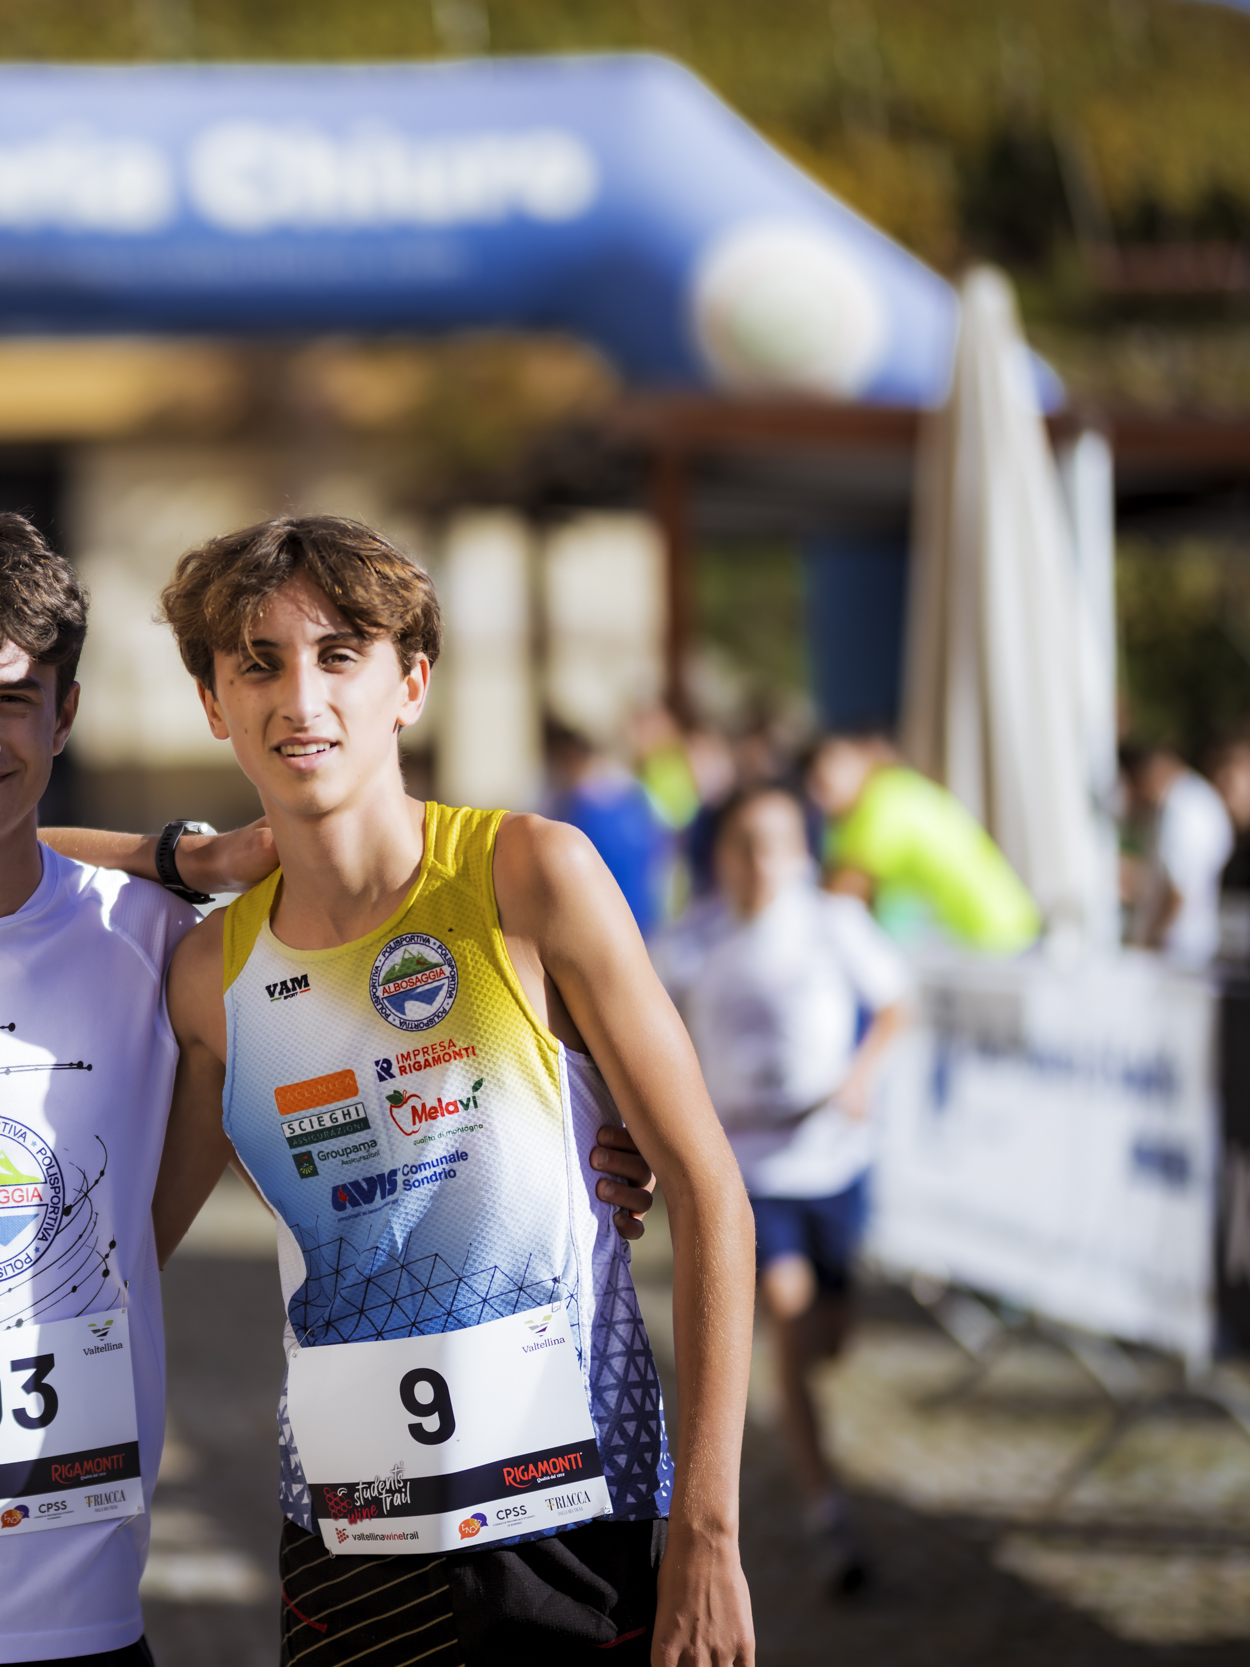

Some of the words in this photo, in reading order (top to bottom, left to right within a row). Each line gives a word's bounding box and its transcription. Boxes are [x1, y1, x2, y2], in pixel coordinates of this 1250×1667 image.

[265, 973, 310, 998] VAM
[382, 967, 446, 997] ALBOSAGGIA
[395, 1038, 457, 1065] IMPRESA
[398, 1045, 476, 1076] RIGAMONTI
[287, 1106, 360, 1135] SCIEGHI
[411, 1090, 481, 1126] Melavi
[292, 1121, 364, 1146] ASSICURAZIONI
[446, 1124, 484, 1135] montagna
[317, 1139, 378, 1161] Groupama
[402, 1149, 469, 1177] Comunale
[332, 1168, 398, 1212] AVIS
[402, 1168, 457, 1192] Sondrio
[36, 1147, 62, 1243] POLISPORTIVA
[82, 1340, 124, 1357] Valtellina
[521, 1336, 566, 1354] Valtellina
[399, 1367, 456, 1445] 9
[51, 1454, 123, 1484] RIGAMONTI
[502, 1452, 583, 1488] RIGAMONTI
[38, 1500, 67, 1514] CPSS
[84, 1490, 126, 1508] TRIACCA
[347, 1504, 378, 1526] wine
[379, 1481, 411, 1515] trail
[544, 1490, 591, 1511] TRIACCA
[496, 1505, 527, 1521] CPSS
[351, 1531, 419, 1541] valtellinawinetrail
